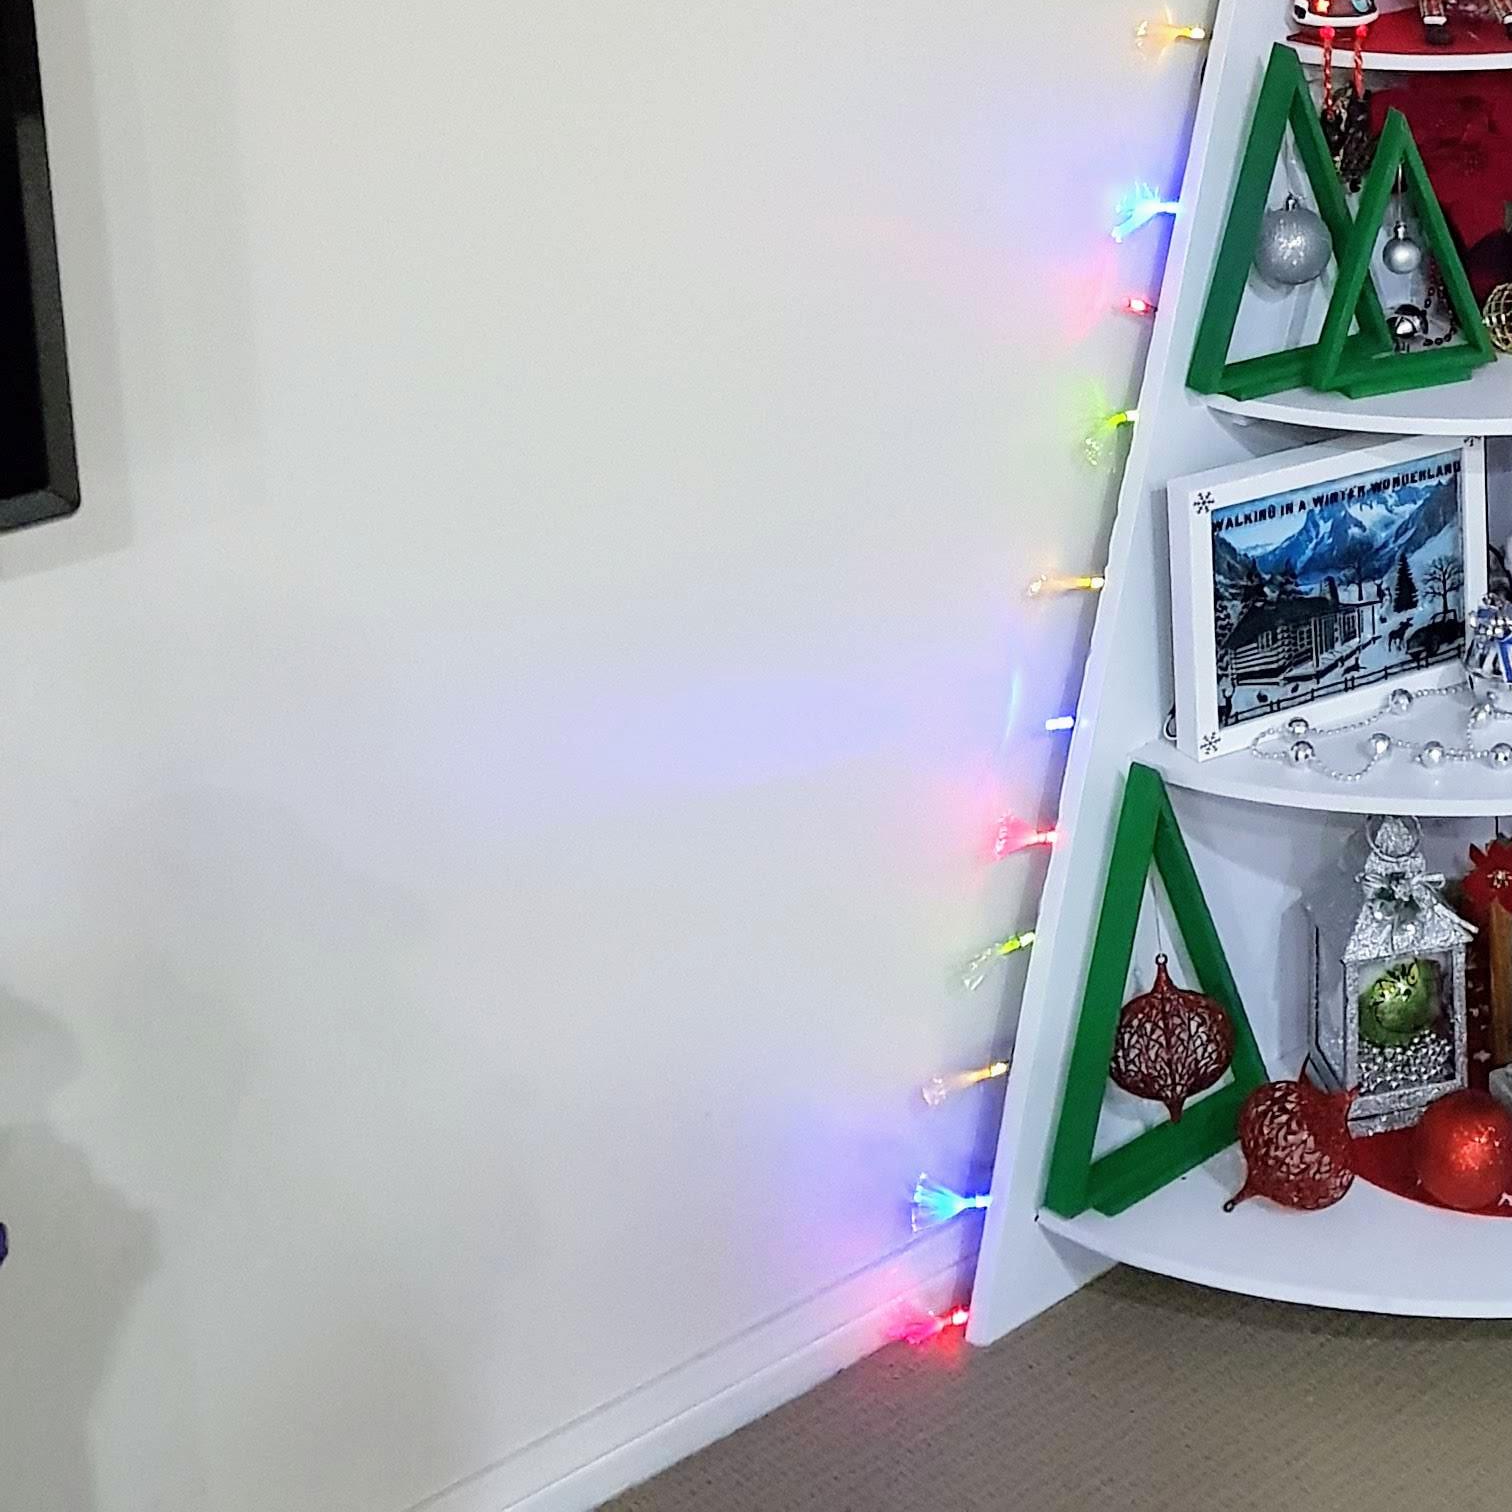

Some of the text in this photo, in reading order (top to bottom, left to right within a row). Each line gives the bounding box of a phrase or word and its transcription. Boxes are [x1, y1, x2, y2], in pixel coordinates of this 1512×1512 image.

[1212, 504, 1276, 532] WALKING
[1281, 502, 1293, 516] IN
[1299, 500, 1306, 512] A
[1313, 486, 1365, 507] WINTER
